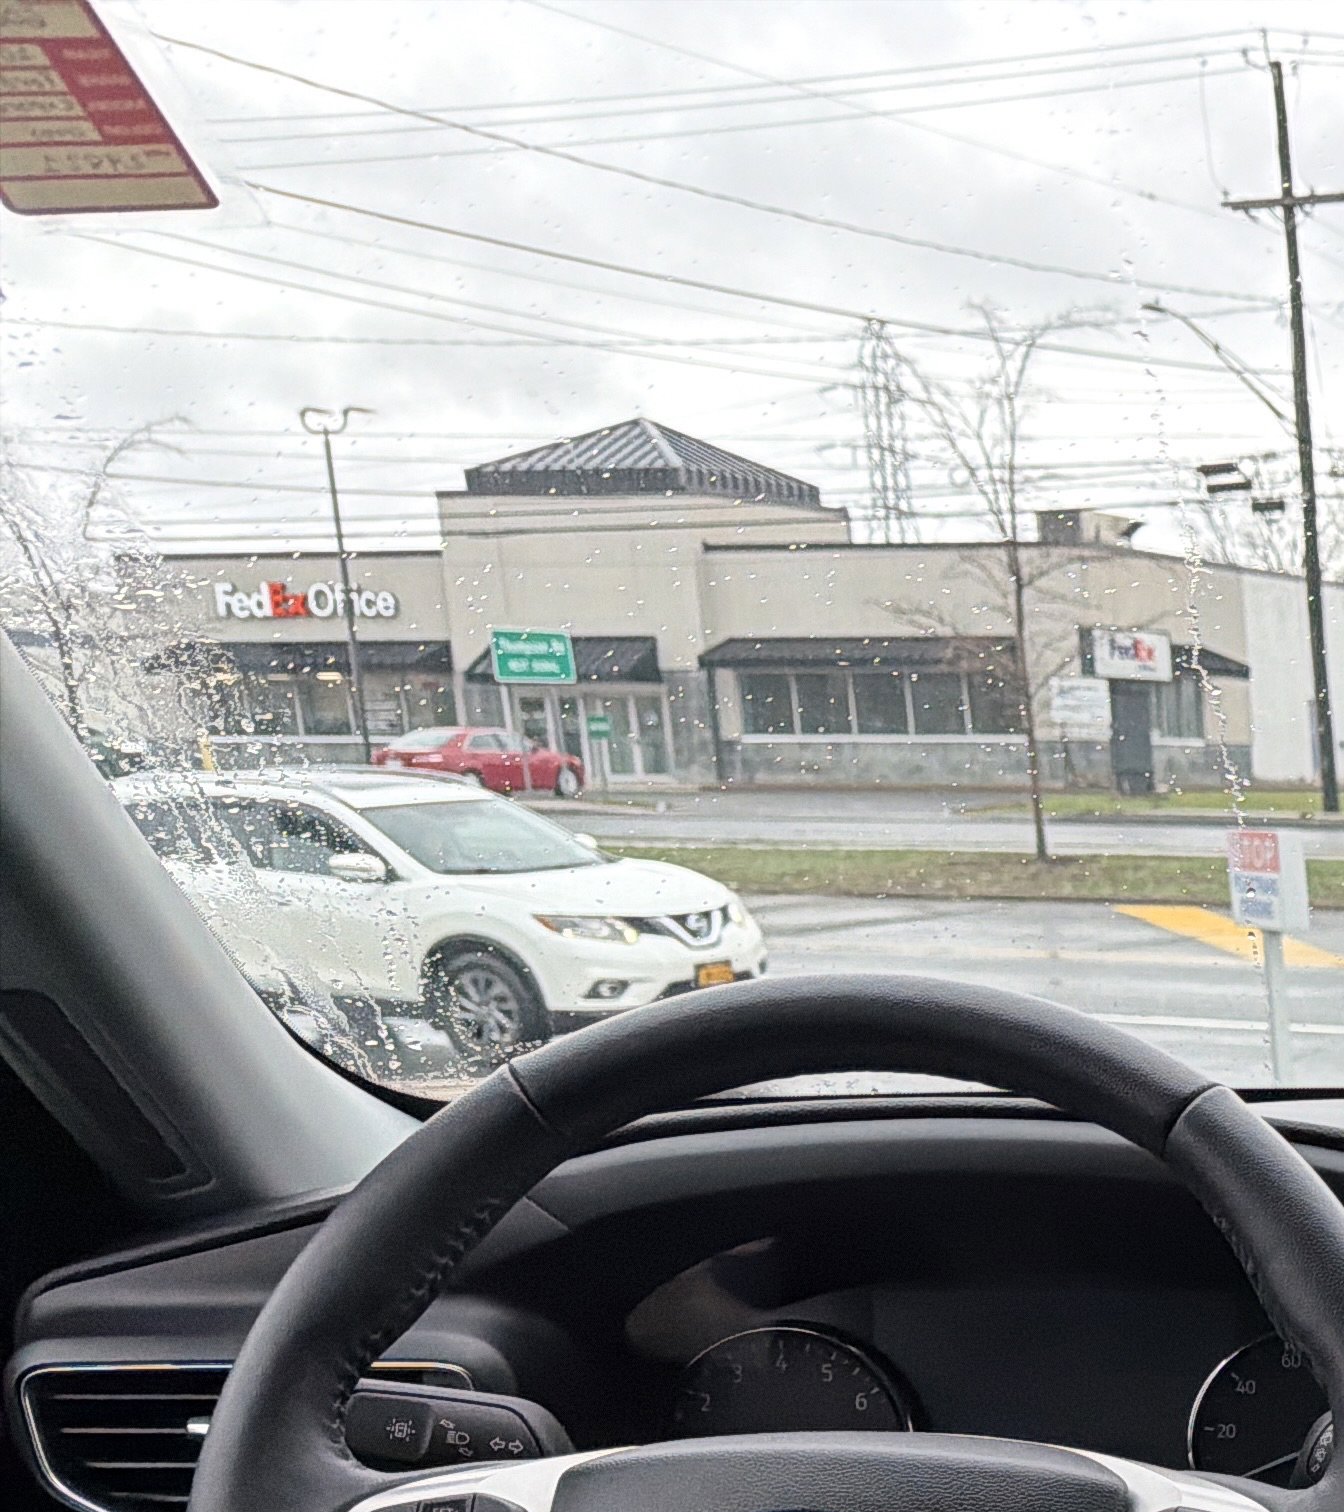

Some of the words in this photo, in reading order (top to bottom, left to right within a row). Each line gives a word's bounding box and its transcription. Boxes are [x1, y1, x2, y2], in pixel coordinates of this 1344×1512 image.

[214, 581, 308, 618] FedEx
[821, 1363, 833, 1382] 5
[1235, 1380, 1256, 1395] 40
[701, 1393, 711, 1411] 2
[855, 1392, 867, 1410] 6
[1217, 1424, 1236, 1439] 20
